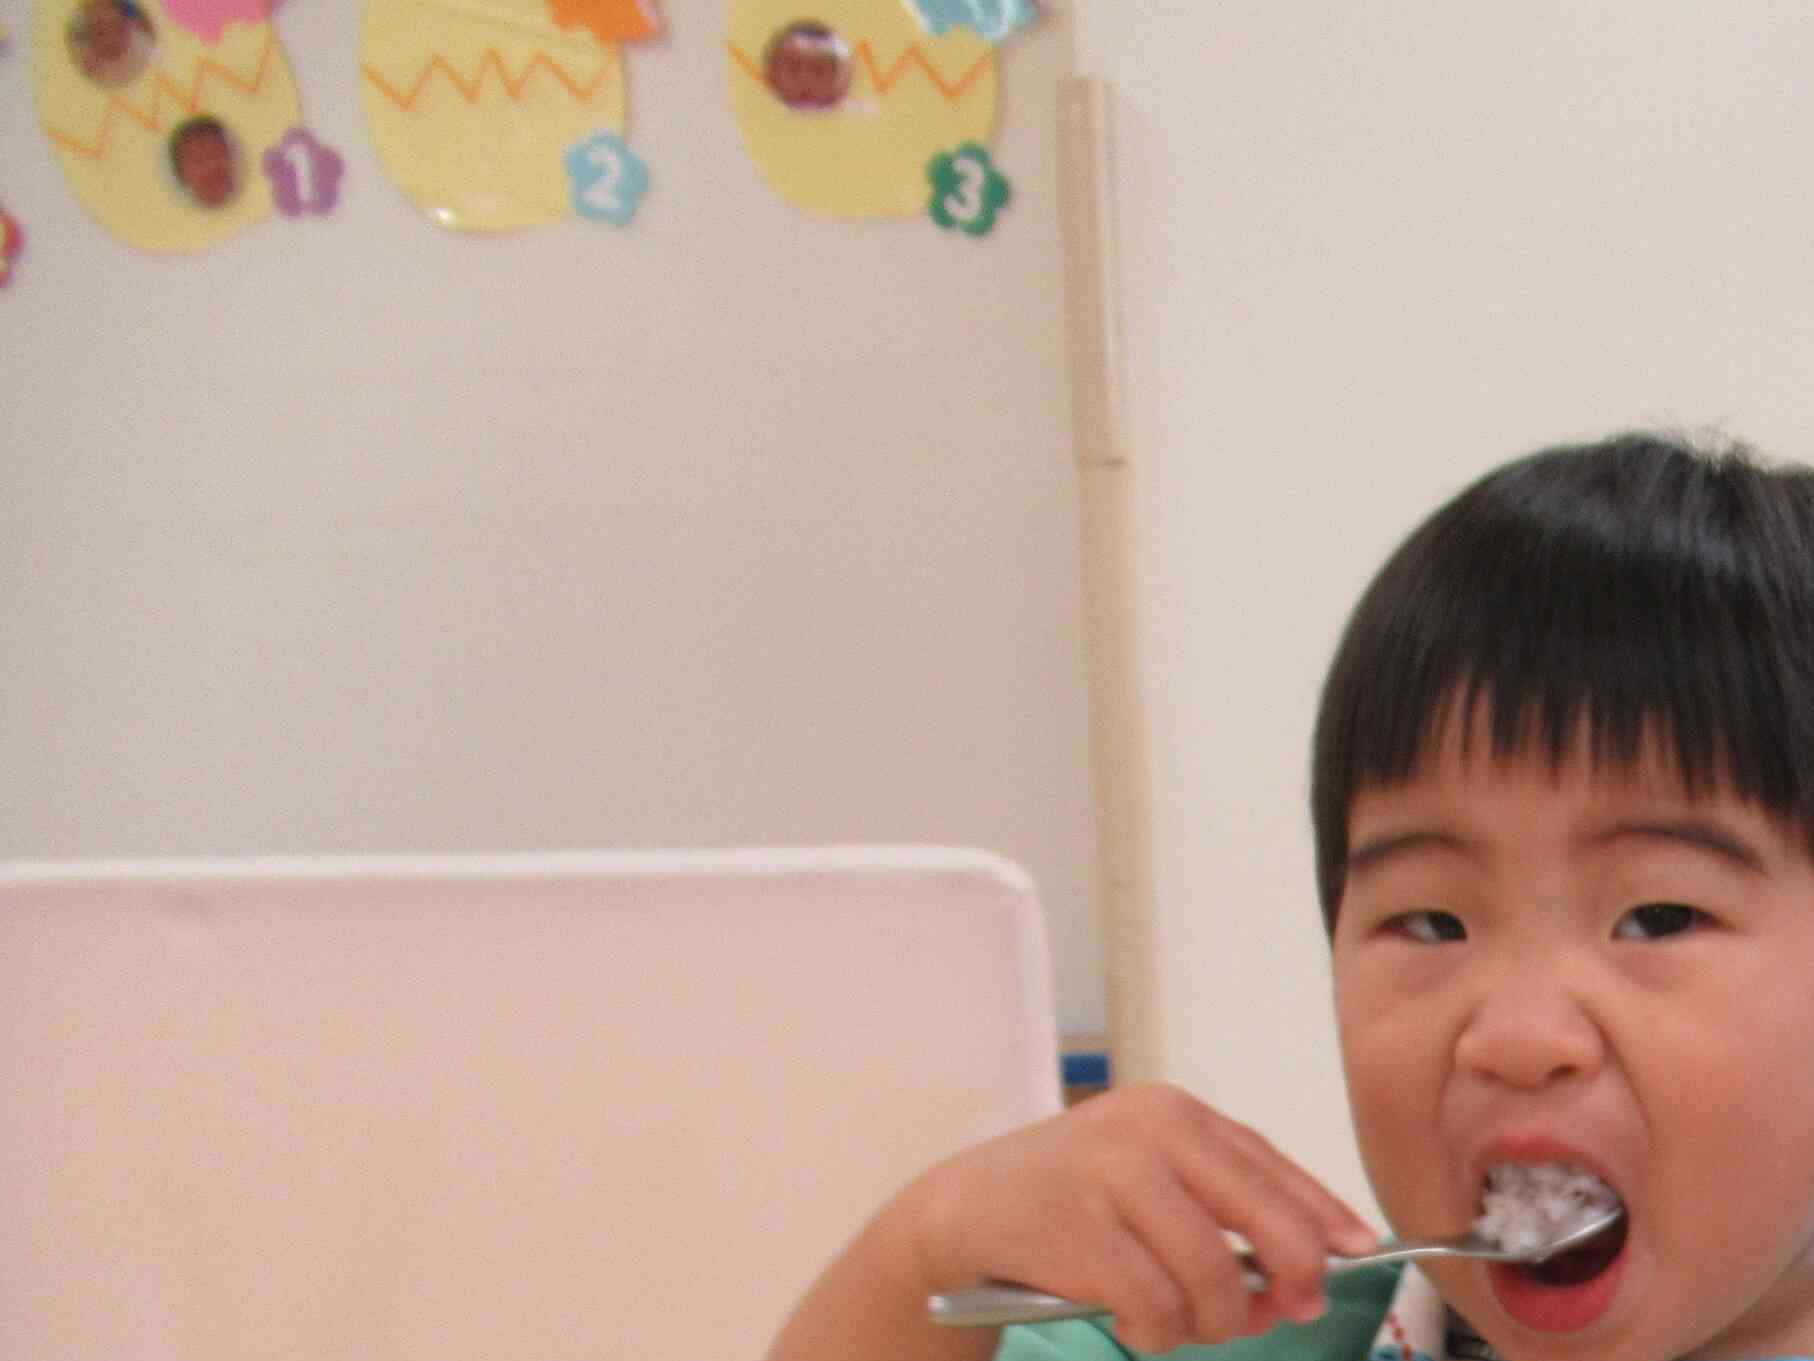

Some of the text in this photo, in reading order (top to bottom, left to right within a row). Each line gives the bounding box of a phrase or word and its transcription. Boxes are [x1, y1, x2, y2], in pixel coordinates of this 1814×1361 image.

[287, 145, 312, 204] 1
[584, 146, 621, 206] 2
[944, 158, 984, 218] 3
